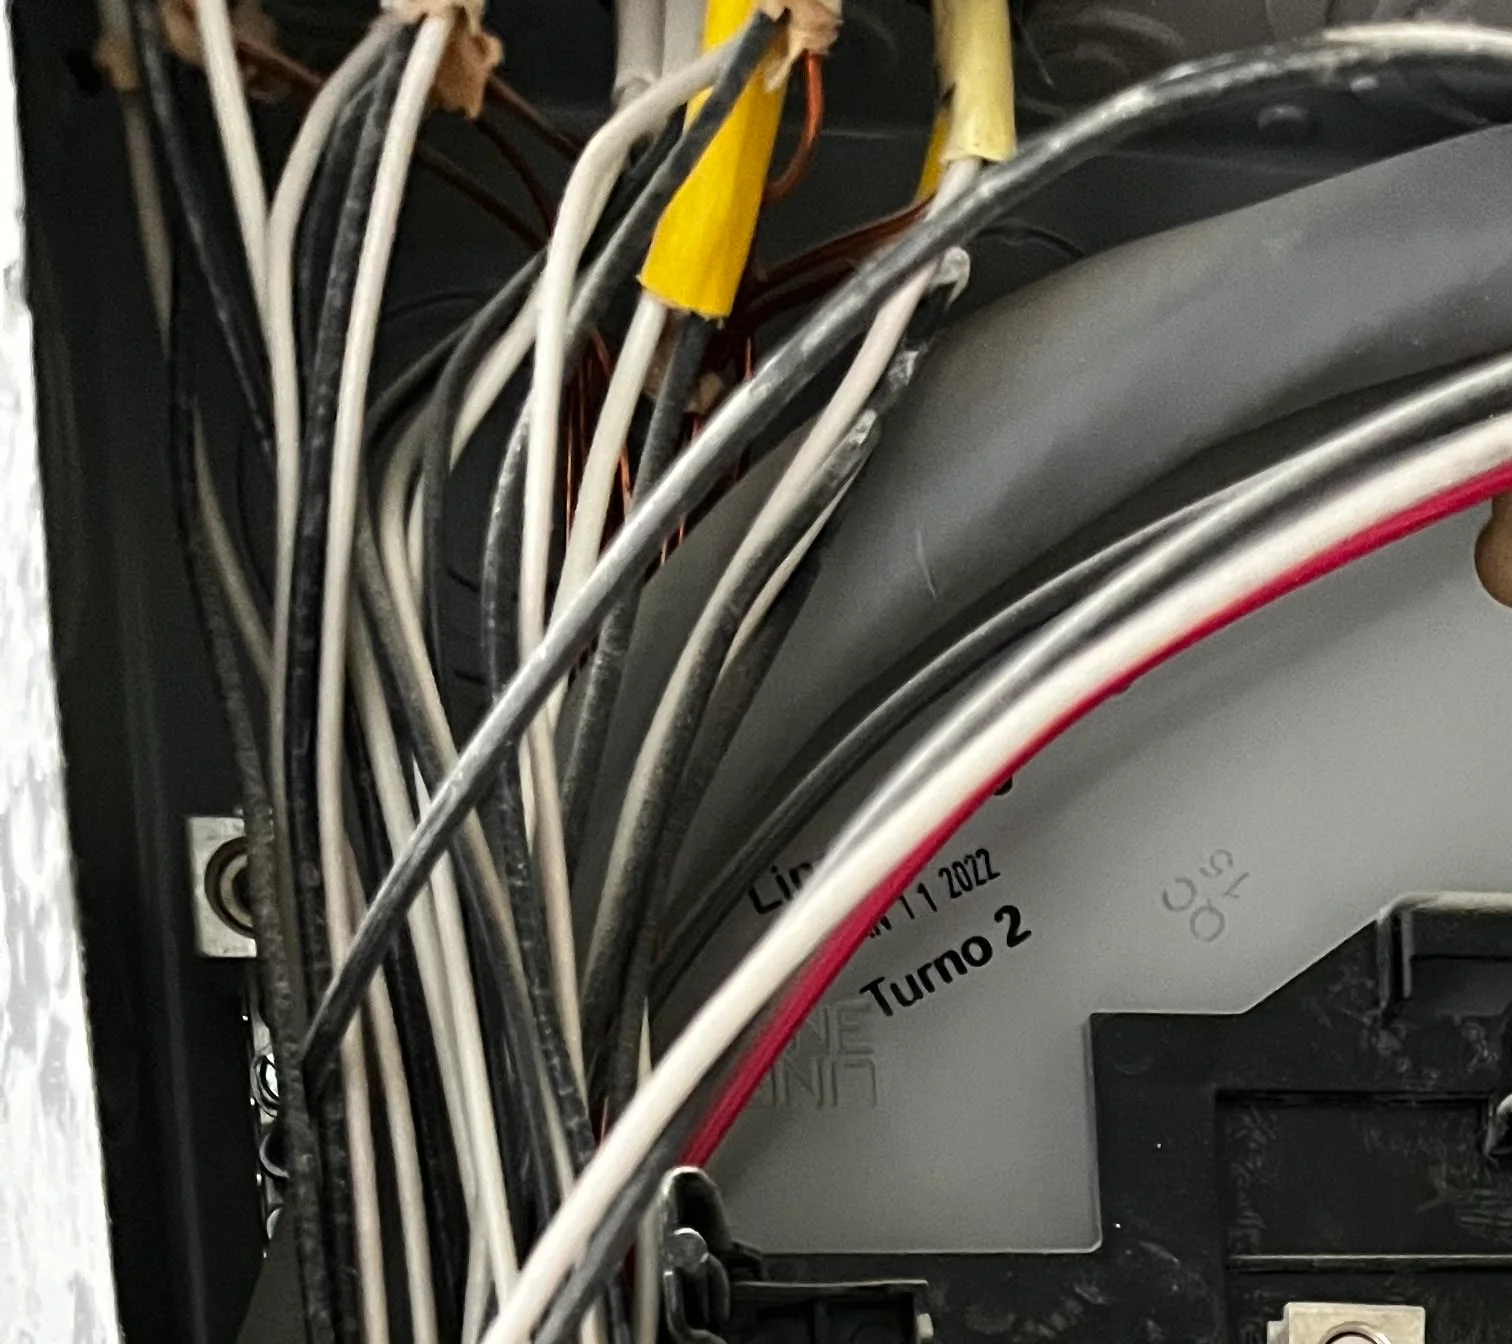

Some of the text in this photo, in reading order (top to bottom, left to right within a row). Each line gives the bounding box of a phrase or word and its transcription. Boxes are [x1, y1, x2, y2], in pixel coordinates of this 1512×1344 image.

[938, 847, 1001, 899] 2022
[859, 904, 1032, 1017] Turno 2
